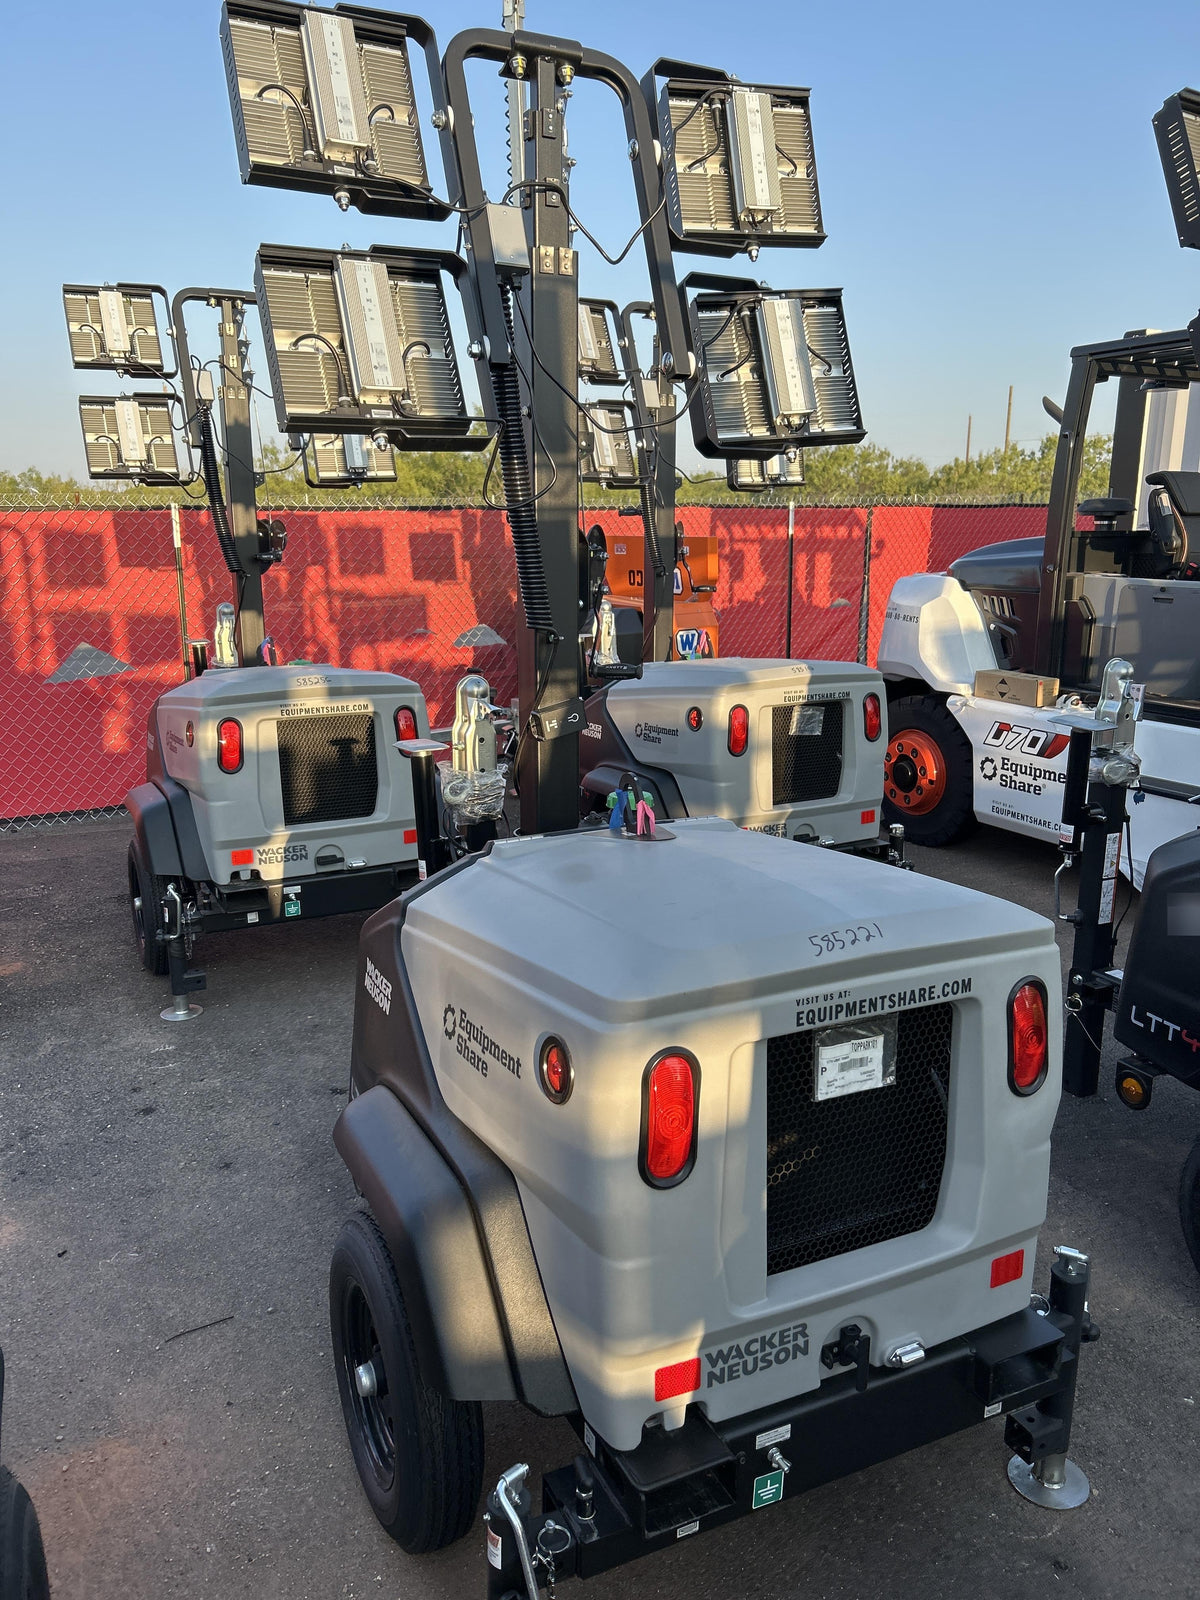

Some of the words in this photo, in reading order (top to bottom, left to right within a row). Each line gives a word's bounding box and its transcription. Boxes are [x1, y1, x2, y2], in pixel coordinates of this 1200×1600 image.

[680, 634, 696, 651] W
[281, 703, 369, 717] EQUIPMENTSHARE.COM
[784, 691, 850, 703] EQUIPMENTSHARE.COM
[643, 732, 662, 744] Share
[644, 722, 679, 737] Equipment
[983, 720, 1049, 757] D70
[1000, 756, 1067, 784] Equipme
[257, 844, 308, 857] WACKER
[258, 853, 308, 866] NEUSON
[808, 922, 884, 957] 585221
[366, 957, 392, 1000] WACKER
[364, 972, 392, 1016] NEUSON
[796, 995, 819, 1007] VISIT
[823, 993, 834, 1001] US
[838, 990, 851, 999] AT:
[796, 977, 972, 1028] EQUIPMENTSHARE.COM
[456, 1033, 489, 1078] Share
[458, 1008, 522, 1079] Equipment
[820, 1066, 828, 1076] P
[705, 1322, 809, 1369] WACKER
[706, 1339, 809, 1389] NEUSON
